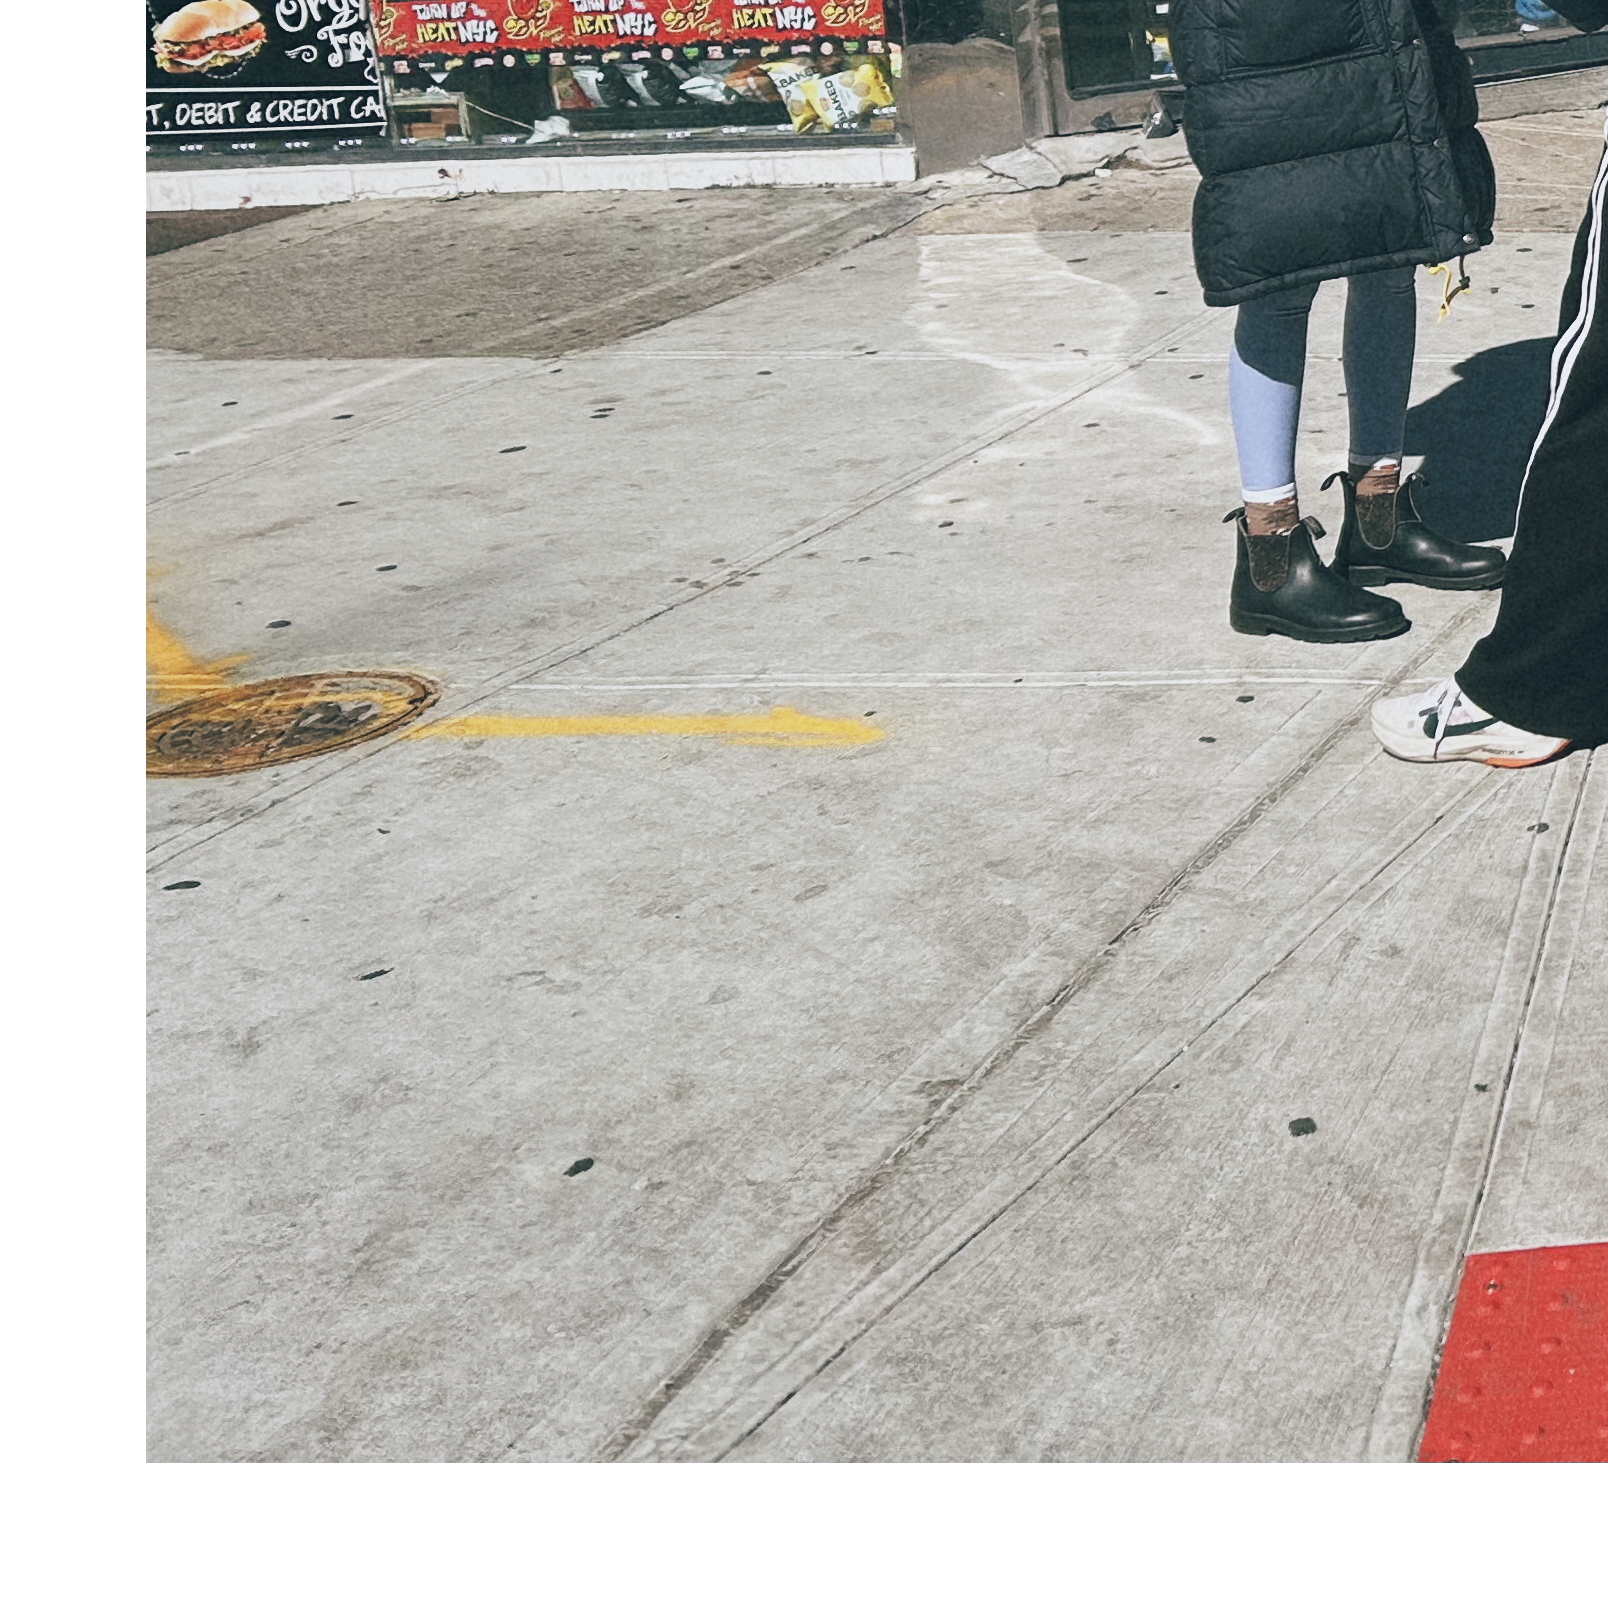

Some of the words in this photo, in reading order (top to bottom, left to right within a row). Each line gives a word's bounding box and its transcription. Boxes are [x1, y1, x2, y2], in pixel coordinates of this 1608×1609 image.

[412, 4, 447, 20] TURN
[450, 2, 467, 19] UP
[731, 7, 774, 29] HEAT
[774, 5, 816, 31] NYC
[416, 22, 458, 43] HEAT
[458, 20, 499, 43] NYC
[573, 14, 614, 35] HEAT
[614, 12, 657, 36] NYC
[175, 100, 241, 126] DEBIT
[246, 101, 262, 124] &
[265, 96, 346, 124] CREDIT
[824, 80, 848, 122] BAKED
